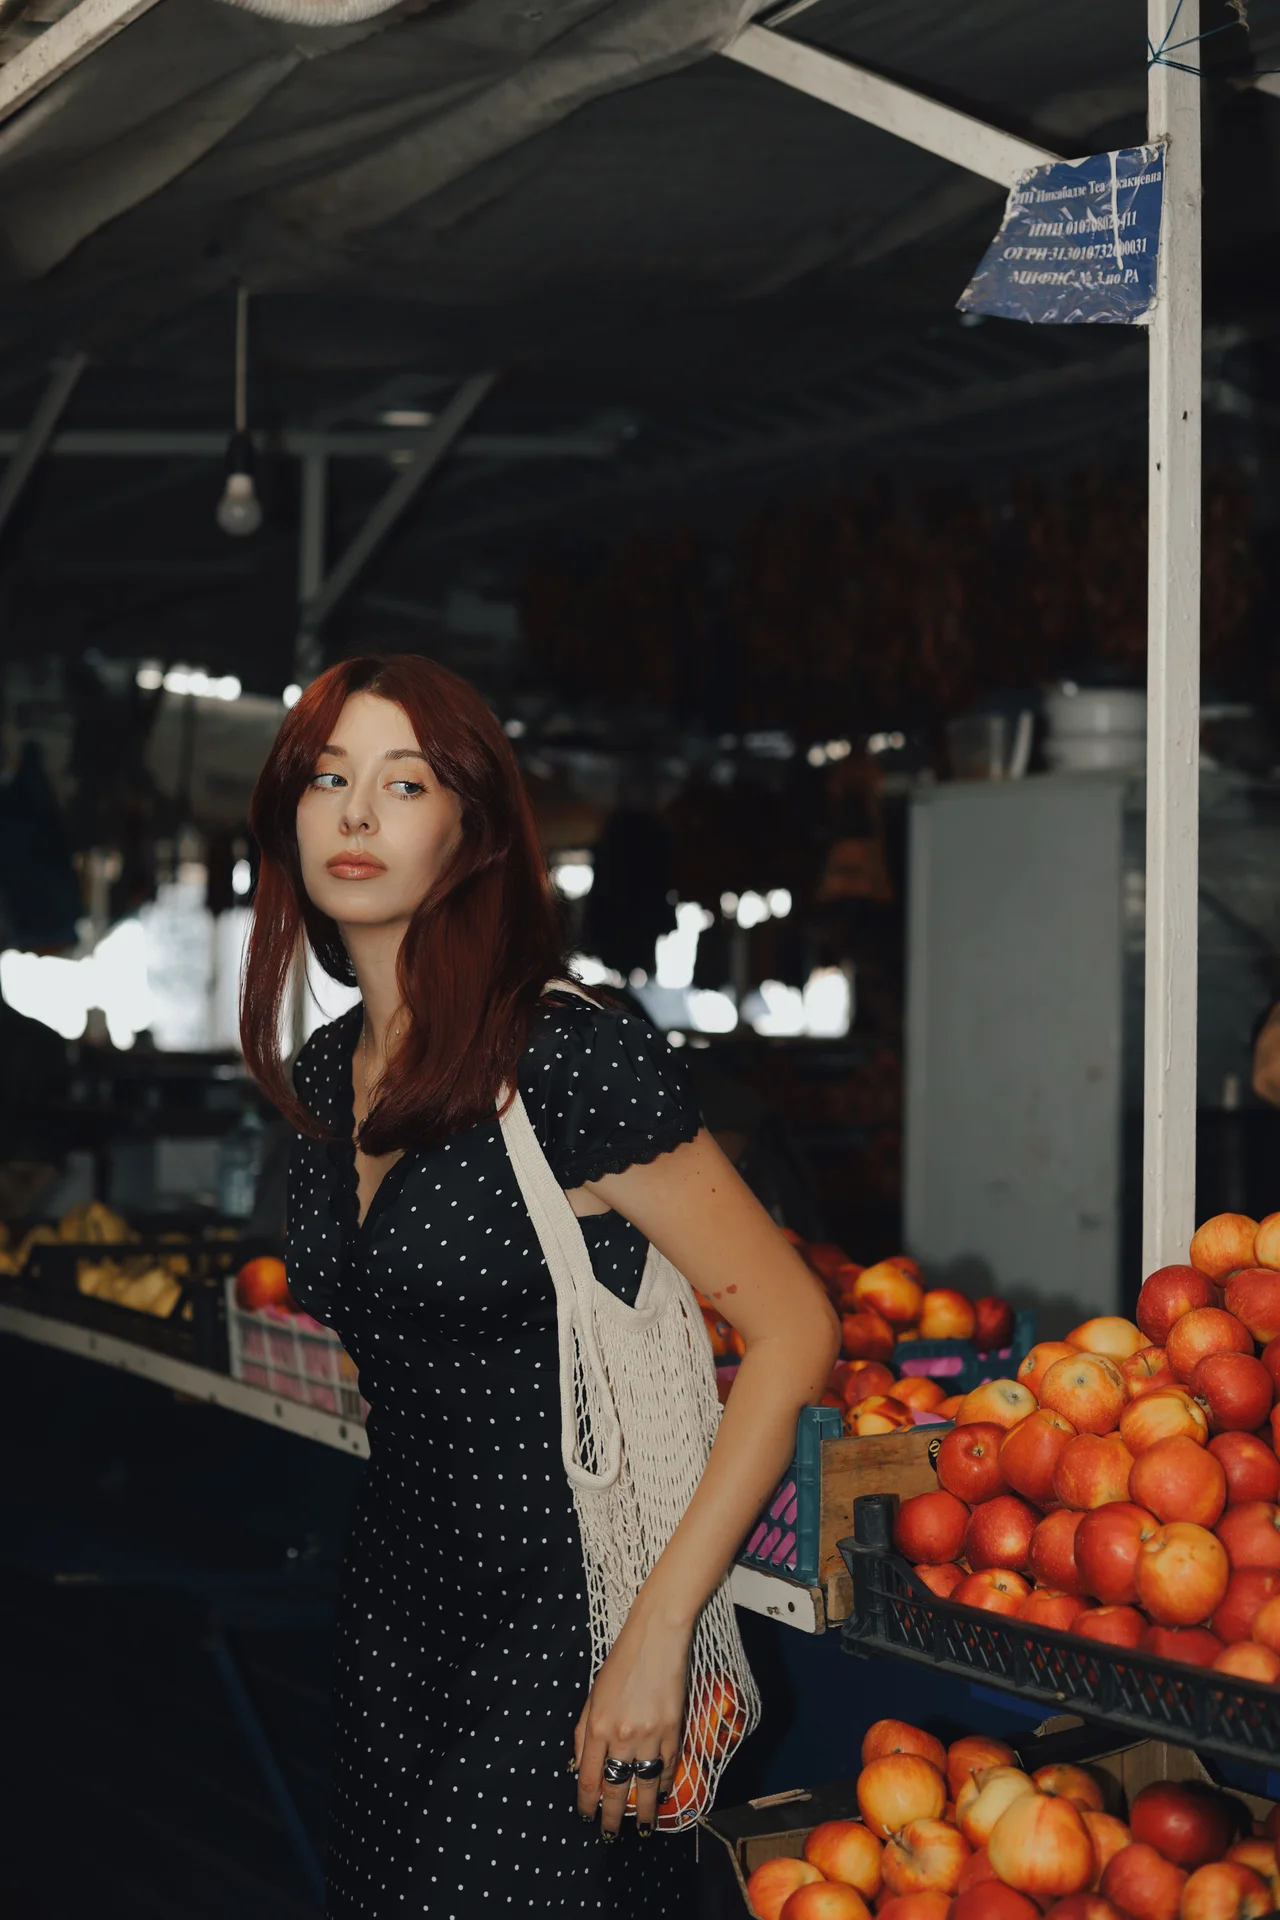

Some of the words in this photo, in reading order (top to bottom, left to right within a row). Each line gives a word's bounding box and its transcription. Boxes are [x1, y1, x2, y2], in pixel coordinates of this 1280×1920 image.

[1088, 180, 1106, 194] Теа
[1109, 171, 1162, 190] какиевна
[1028, 222, 1063, 237] ИНН
[1123, 268, 1139, 284] РА
